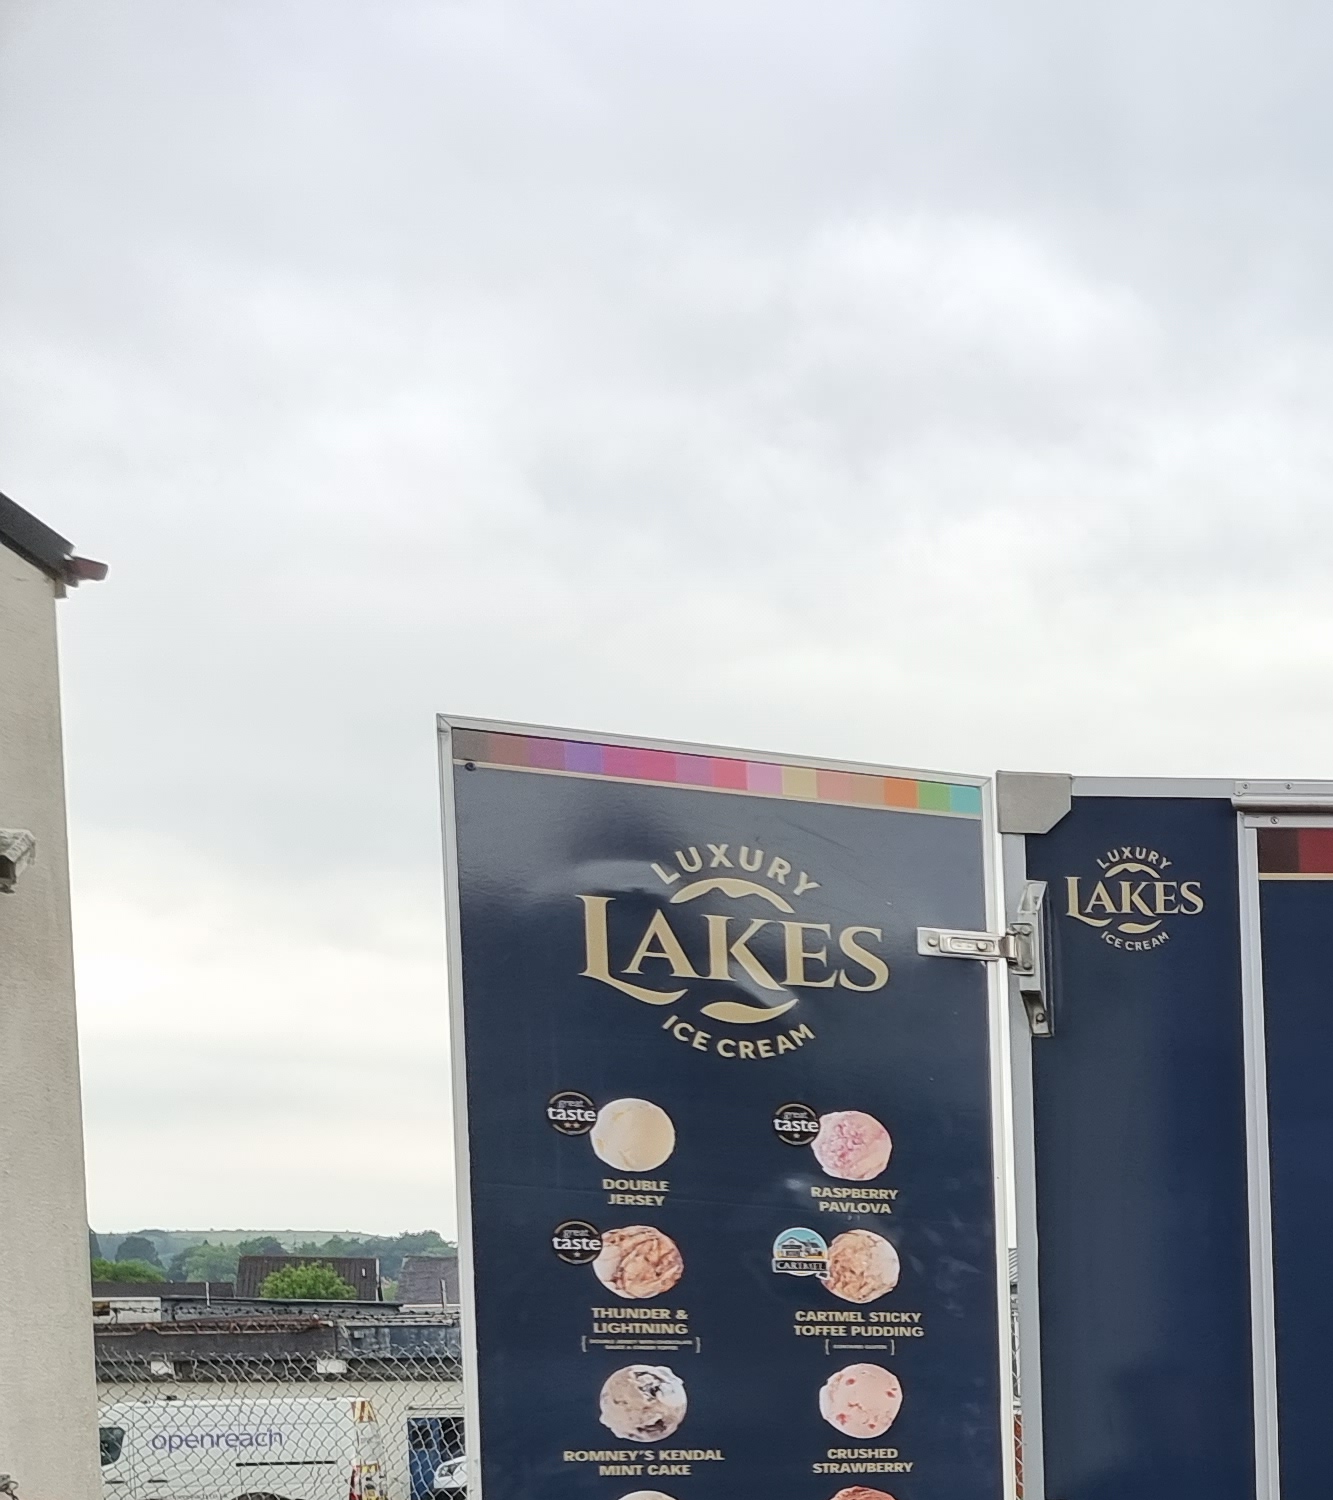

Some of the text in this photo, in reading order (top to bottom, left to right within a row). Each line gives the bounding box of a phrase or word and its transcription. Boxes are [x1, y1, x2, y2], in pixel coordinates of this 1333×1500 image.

[1096, 847, 1172, 870] LUXURY
[651, 843, 821, 897] LUXURY
[1064, 876, 1204, 927] LAKES
[1101, 931, 1170, 951] ICE CREAM
[575, 894, 890, 1005] LAKES
[661, 1014, 816, 1060] ICE CREAM
[548, 1107, 596, 1122] taste
[773, 1118, 819, 1132] taste
[602, 1178, 670, 1192] DOUBLE
[608, 1194, 665, 1206] JERSEY
[811, 1187, 898, 1200] RASPBERRY
[819, 1202, 892, 1214] PAVLOVA
[552, 1237, 601, 1250] taste
[591, 1308, 688, 1319] THUNDER &
[795, 1311, 922, 1323] CARTMEL STICKY
[593, 1322, 688, 1334] LIGHTNING
[794, 1325, 924, 1337] TOFFEE PUDDING
[151, 1429, 283, 1452] openreach
[659, 1450, 725, 1461] KENDAL
[827, 1449, 898, 1459] CRUSHED
[599, 1465, 692, 1476] MINT CAKE
[812, 1462, 913, 1473] STRAWBERRY
